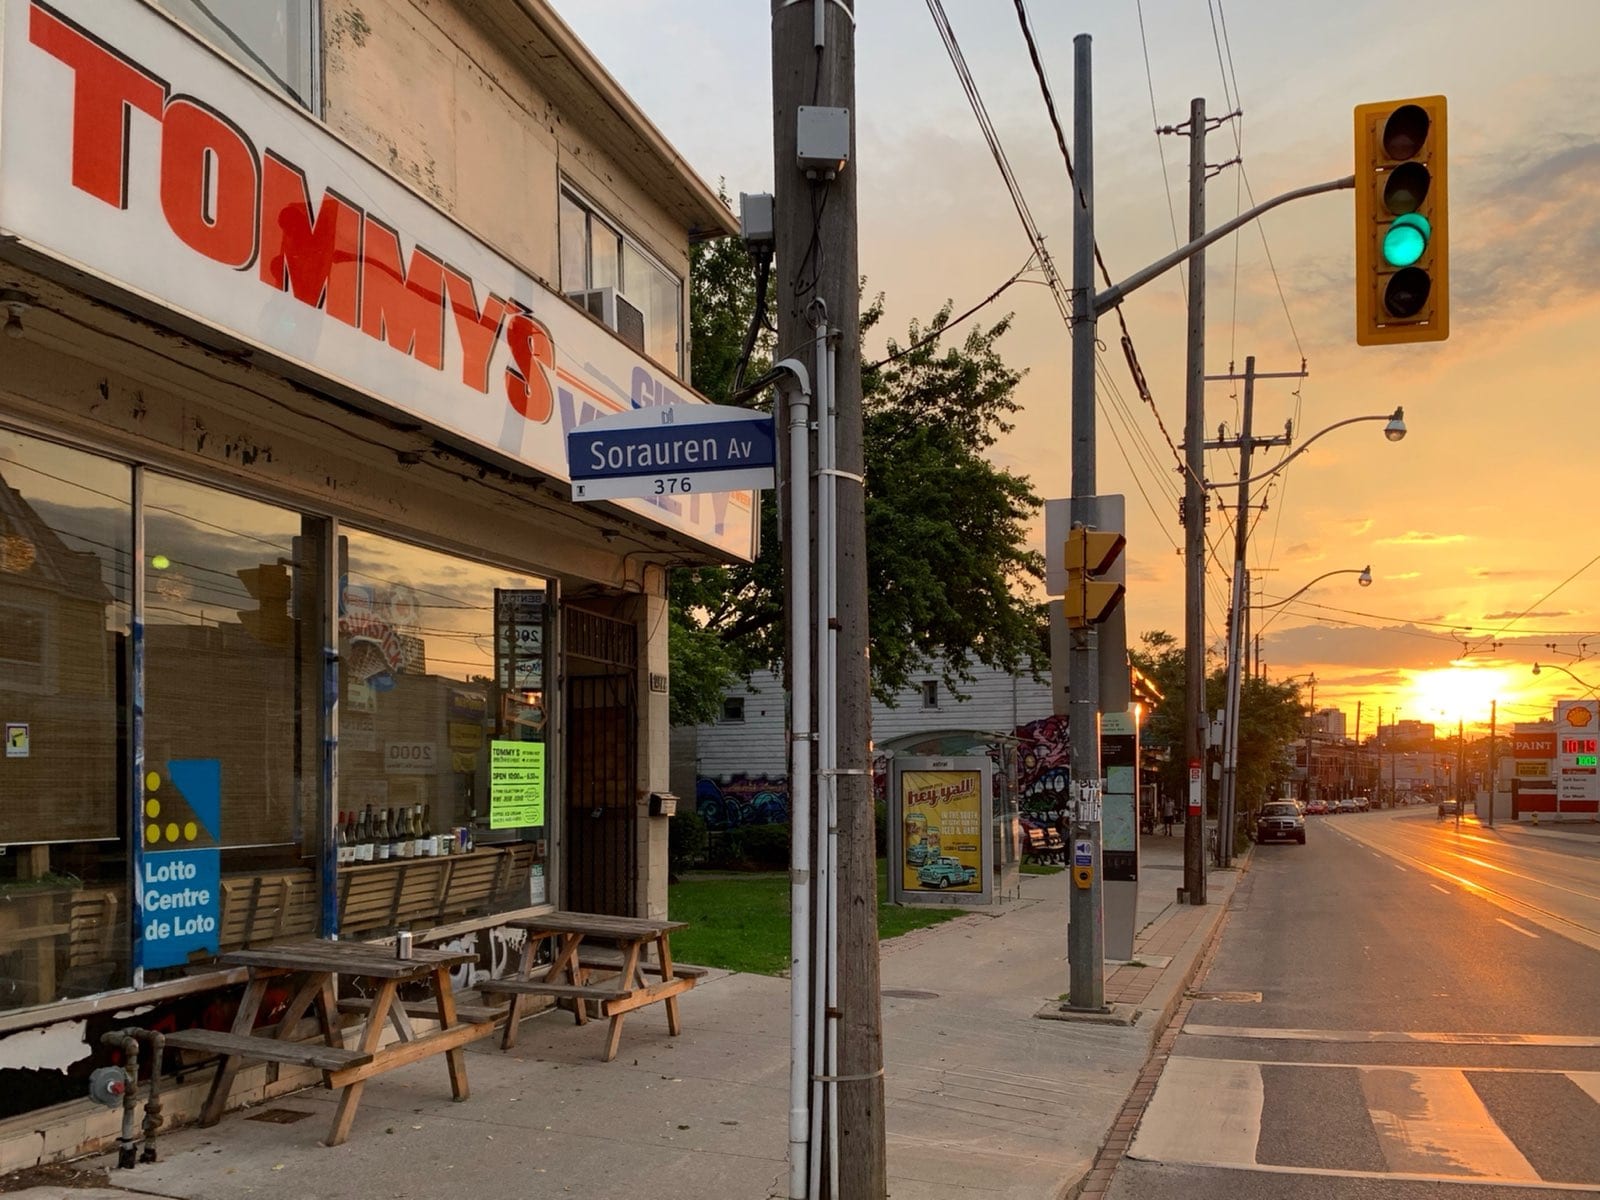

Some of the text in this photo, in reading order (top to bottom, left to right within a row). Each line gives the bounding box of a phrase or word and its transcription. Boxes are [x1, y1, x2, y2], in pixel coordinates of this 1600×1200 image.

[590, 437, 752, 471] Sorauren Av
[654, 477, 692, 495] 376
[1516, 741, 1552, 750] PAINT
[908, 789, 938, 806] hey
[145, 860, 196, 883] Lotto
[144, 887, 210, 912] Centre
[145, 914, 215, 941] de Loto
